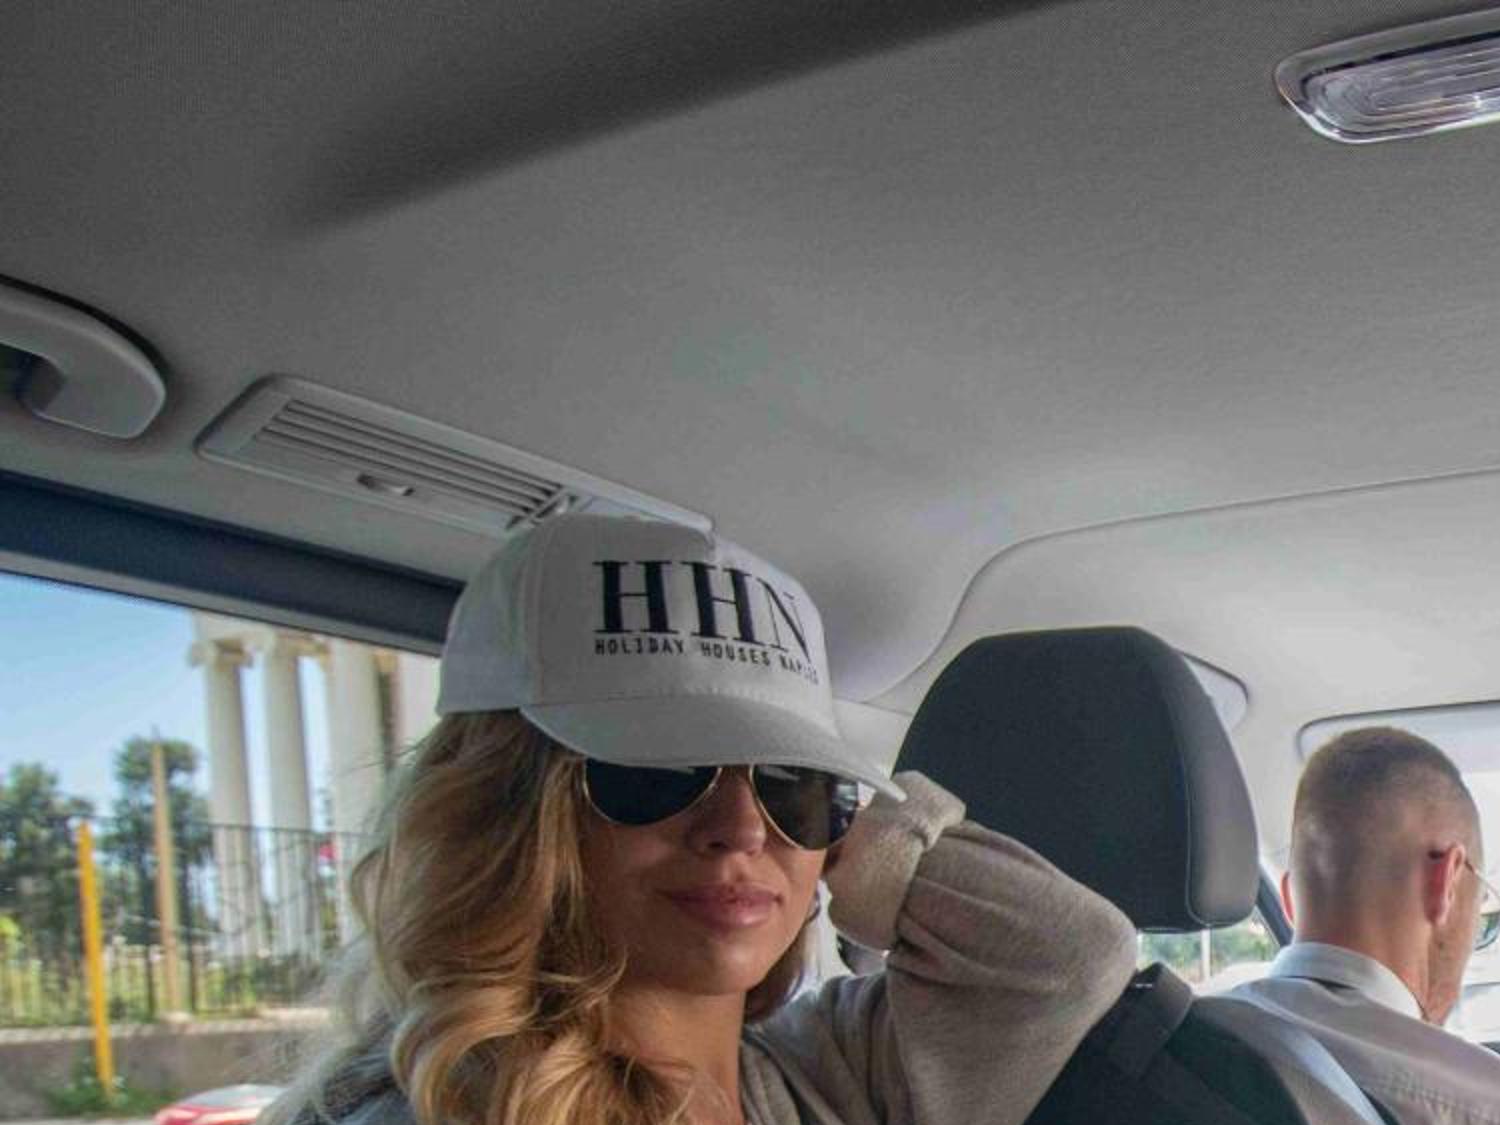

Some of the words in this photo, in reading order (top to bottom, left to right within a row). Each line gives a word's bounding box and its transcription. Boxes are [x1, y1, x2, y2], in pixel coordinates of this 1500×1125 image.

[592, 560, 813, 664] HHN
[594, 638, 685, 656] HOLIDAY
[700, 640, 771, 667] HOUSES
